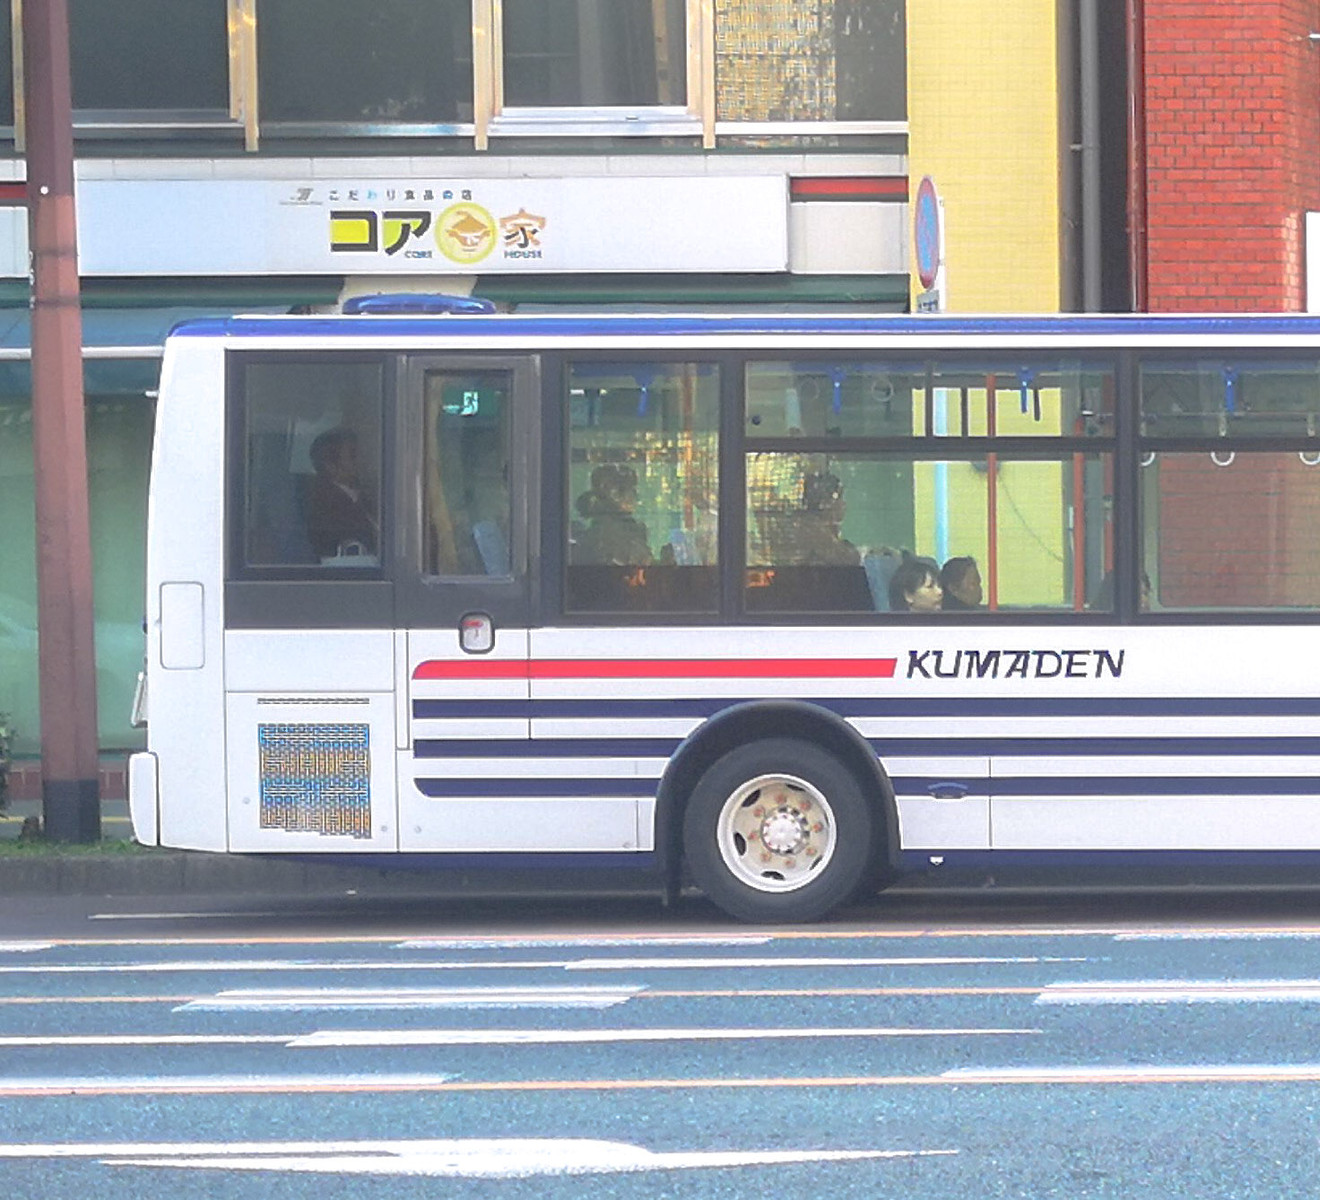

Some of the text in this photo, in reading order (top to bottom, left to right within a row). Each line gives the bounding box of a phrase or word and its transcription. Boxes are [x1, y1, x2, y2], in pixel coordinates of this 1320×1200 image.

[329, 189, 472, 201] こだわり食品の店
[329, 207, 546, 256] コア 家
[404, 250, 543, 259] CORE HOUSE
[906, 649, 1125, 679] KUMADEN
